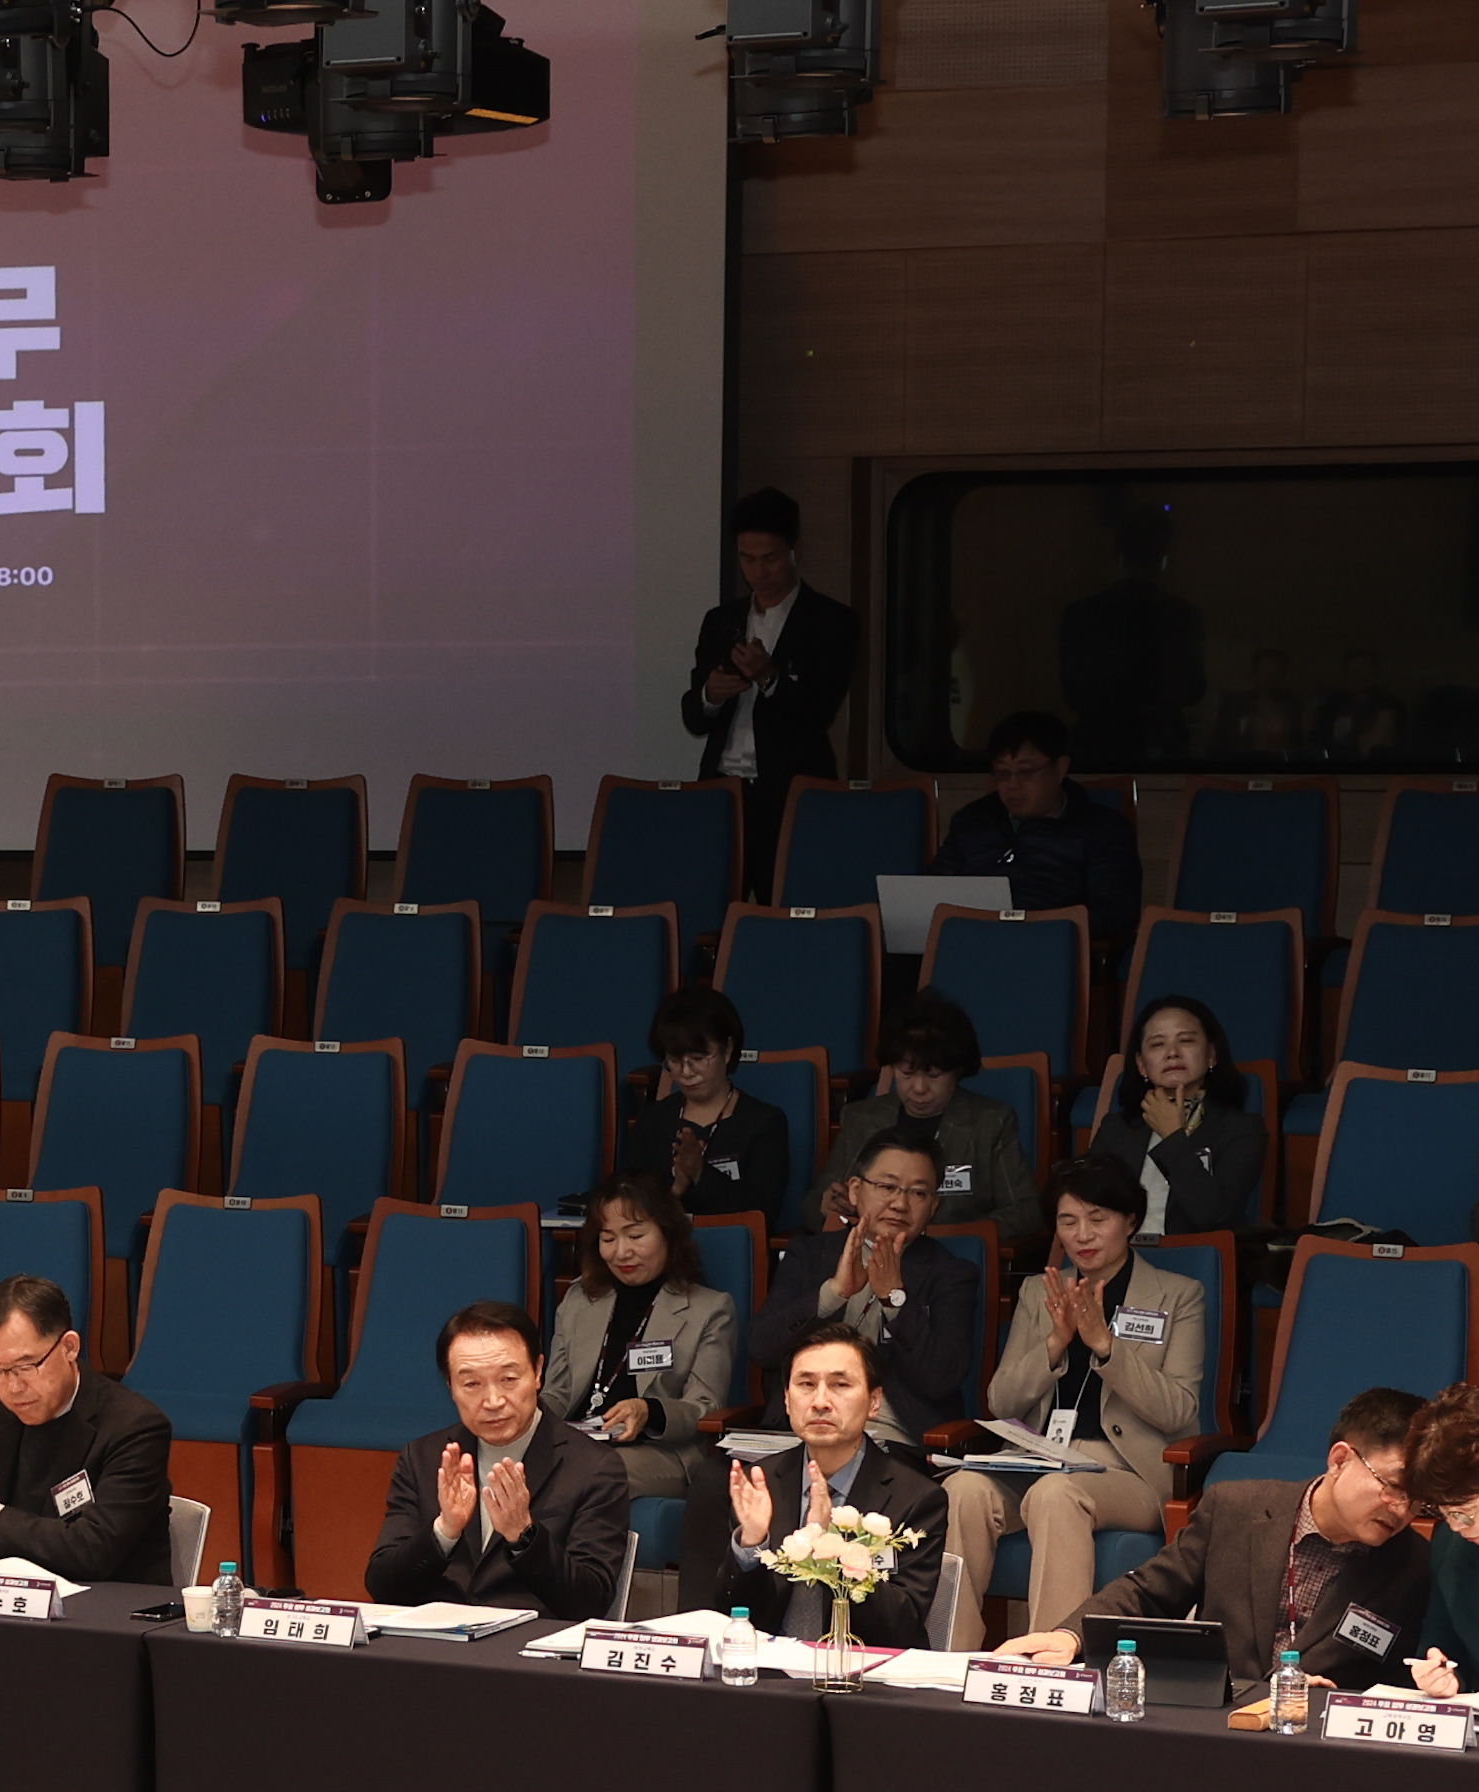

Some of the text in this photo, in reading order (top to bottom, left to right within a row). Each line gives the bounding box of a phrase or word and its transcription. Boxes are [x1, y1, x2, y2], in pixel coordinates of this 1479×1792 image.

[263, 1618, 330, 1641] 임태희
[607, 1649, 676, 1673] 김진수
[990, 1682, 1065, 1708] 홍정표
[1354, 1718, 1437, 1744] 고아영
